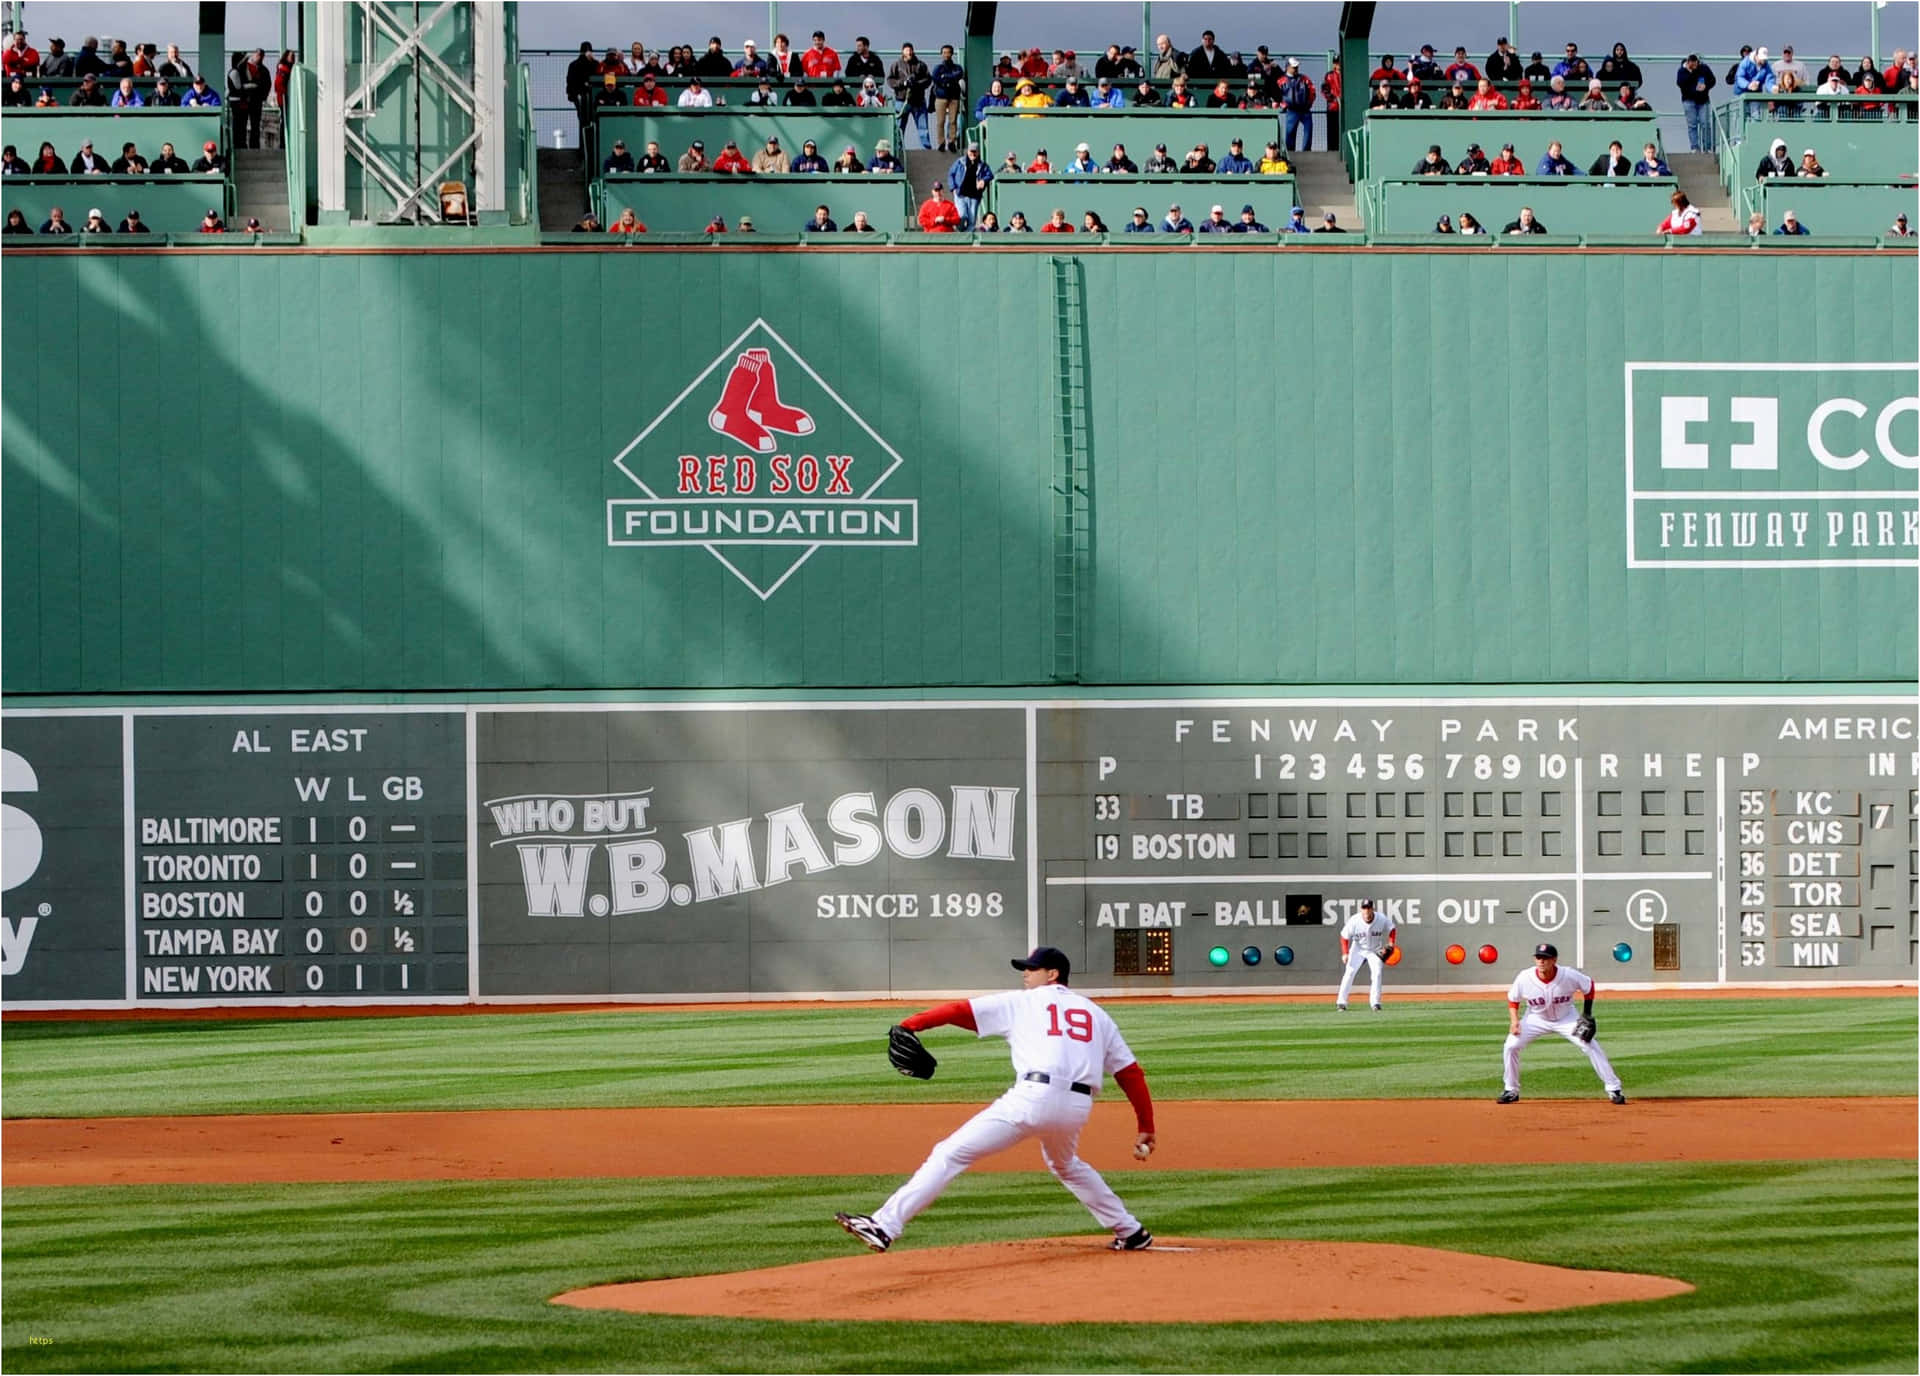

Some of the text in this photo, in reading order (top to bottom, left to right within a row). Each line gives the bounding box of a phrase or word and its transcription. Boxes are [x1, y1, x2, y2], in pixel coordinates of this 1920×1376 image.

[1807, 397, 1919, 470] CO
[678, 455, 853, 495] RED SOX
[625, 509, 900, 535] FOUNDATION
[1660, 511, 1919, 548] FENWAY PARK
[232, 728, 368, 753] AL EAST
[1175, 718, 1579, 743] FENWAY PARK
[1778, 717, 1919, 740] AMERIC
[1099, 756, 1117, 781] P
[1279, 753, 1296, 780] 2
[1309, 753, 1326, 781] 3
[1347, 752, 1366, 779] 4
[1377, 753, 1395, 781] 5
[1404, 753, 1425, 780] 6
[1445, 753, 1463, 779] 7
[1474, 754, 1493, 780] 8
[1502, 754, 1521, 780] 9
[1539, 753, 1567, 780] 10
[1600, 753, 1619, 778] R
[1644, 753, 1662, 777] H
[1686, 753, 1702, 777] E
[1742, 752, 1764, 778] P
[1869, 752, 1896, 777] IN
[294, 776, 424, 802] W L GB
[490, 797, 650, 835] WHO BUT
[1095, 793, 1204, 820] 33 TB
[1740, 790, 1833, 816] 55 KC
[142, 817, 281, 843] BALTIMORE
[348, 816, 367, 842] 0
[1875, 805, 1890, 830] 7
[1740, 820, 1843, 845] 56 CWS
[1097, 833, 1236, 860] 19 BOSTON
[143, 854, 261, 881] TORONTO
[349, 853, 367, 879] 0
[1741, 852, 1842, 877] 36 DET
[143, 891, 244, 918] BOSTON
[305, 890, 323, 916] 0
[349, 890, 367, 916] 0
[816, 892, 1004, 919] SINCE 1898
[1741, 882, 1842, 906] 25 TOR
[1096, 902, 1130, 928] AT
[1138, 901, 1187, 928] BAT
[1215, 899, 1287, 926] BALL
[1437, 898, 1500, 925] OUT
[1539, 901, 1557, 924] H
[1639, 899, 1655, 922] E
[1742, 912, 1842, 937] 45 SEA
[143, 929, 224, 956] TAMPA
[232, 928, 279, 955] BAY
[305, 927, 323, 953] 0
[350, 927, 368, 953] 0
[1147, 931, 1170, 972] 3
[1742, 942, 1839, 967] 53 MIN
[144, 966, 200, 993] NEW
[206, 965, 272, 993] YORK
[306, 964, 324, 991] 0
[1046, 1003, 1093, 1043] 19
